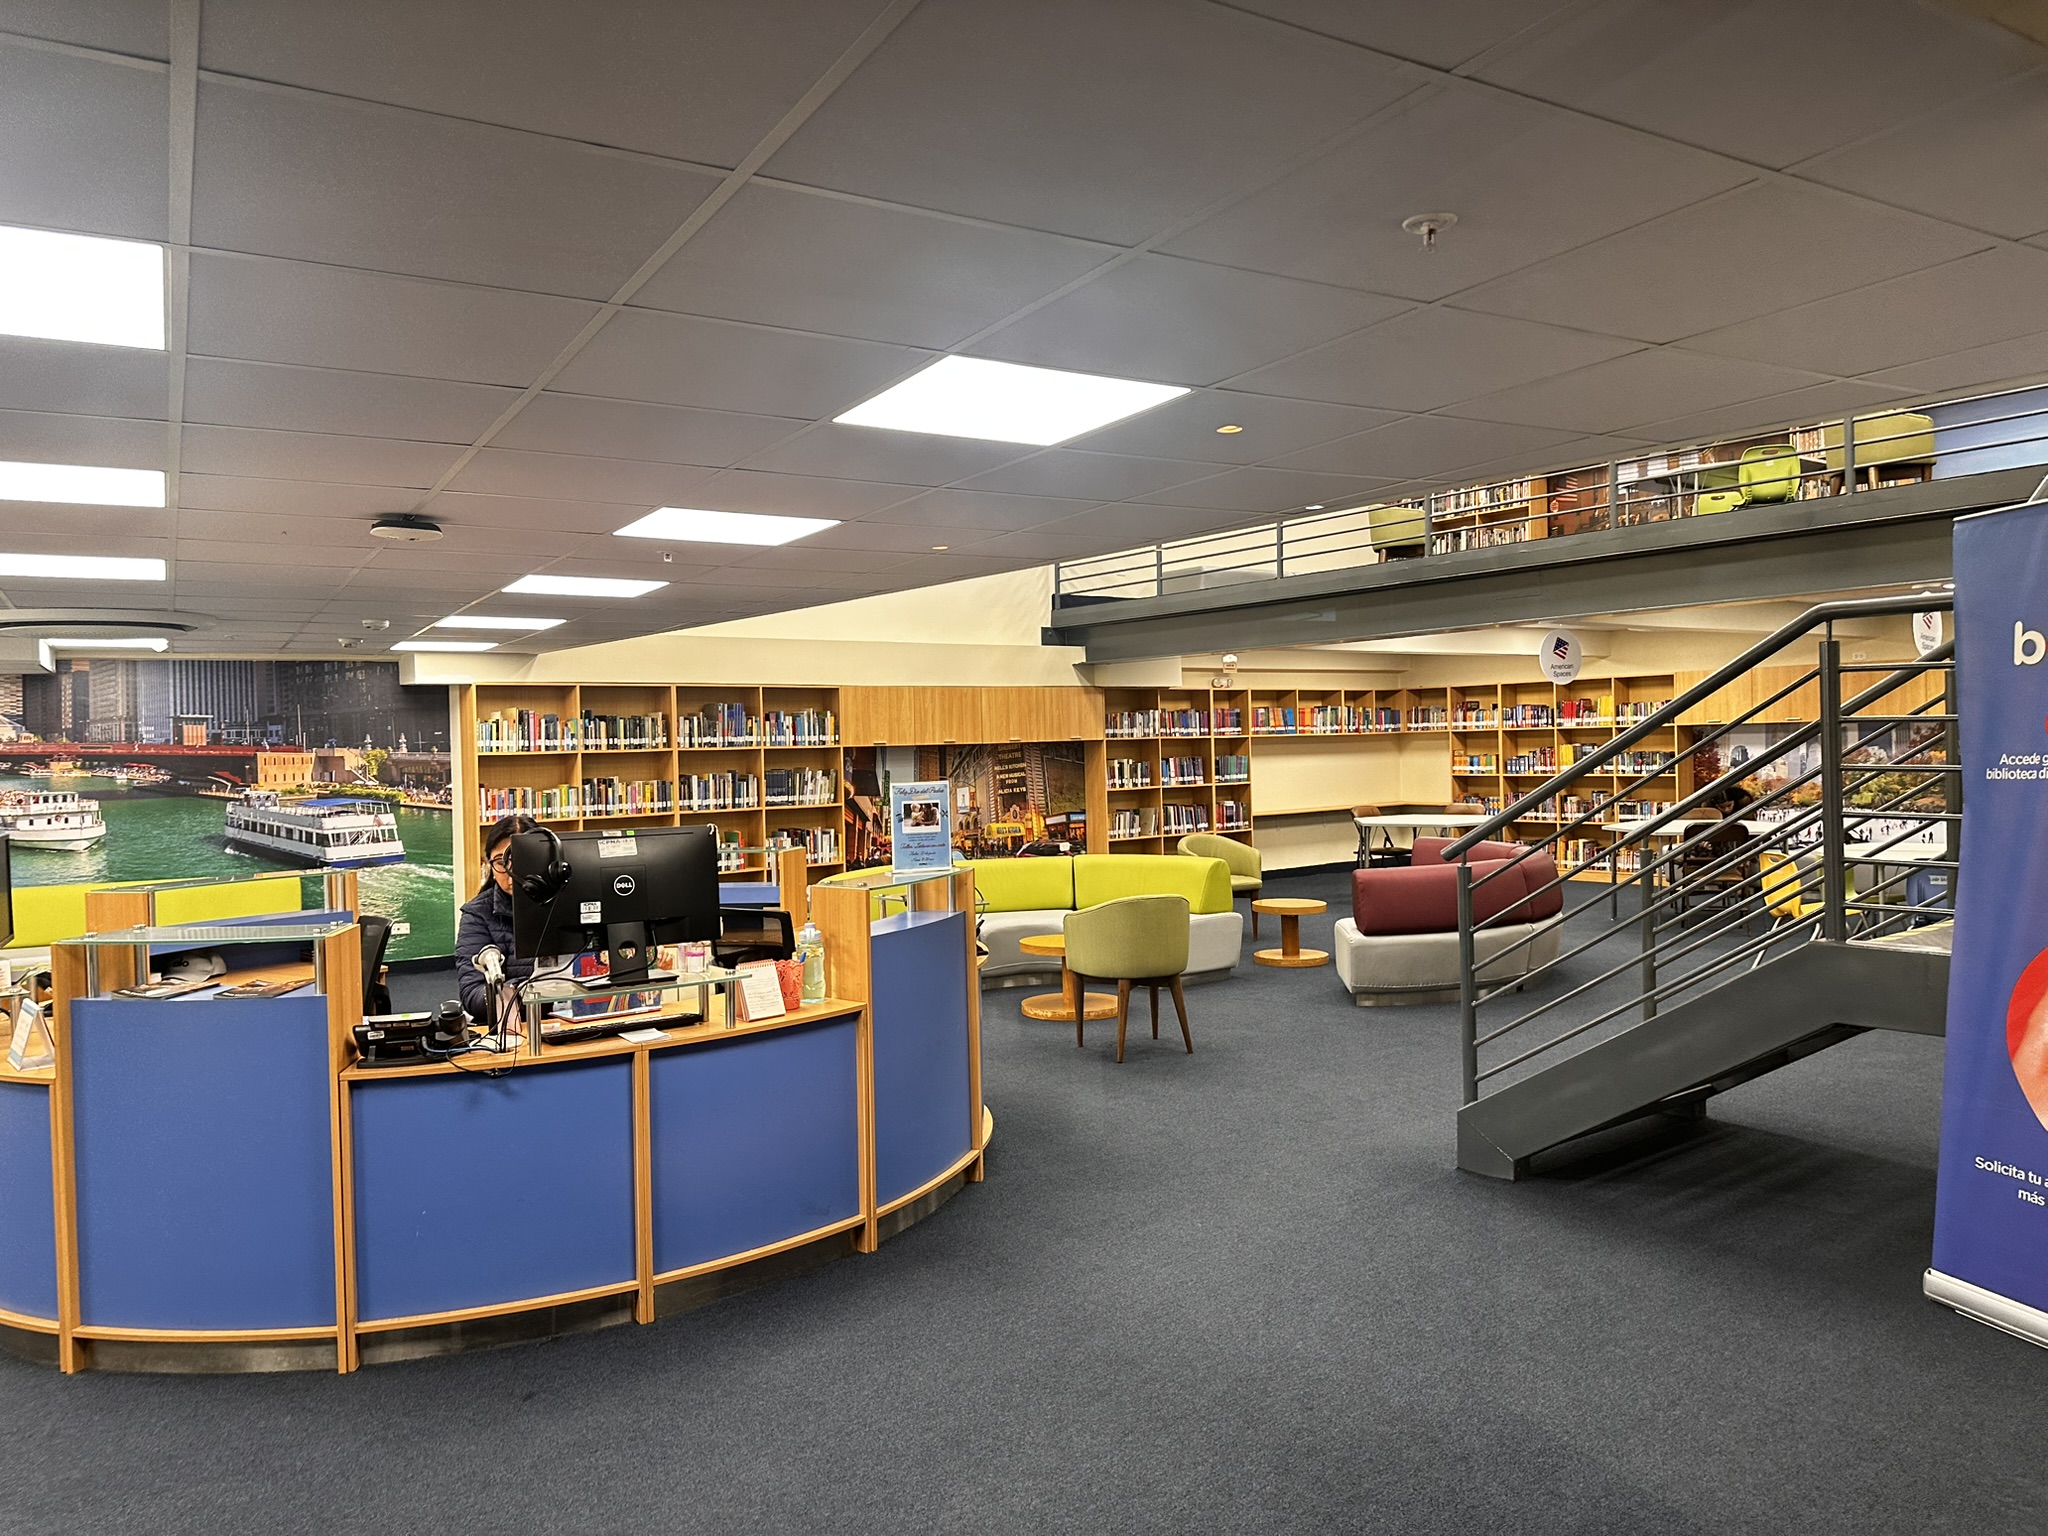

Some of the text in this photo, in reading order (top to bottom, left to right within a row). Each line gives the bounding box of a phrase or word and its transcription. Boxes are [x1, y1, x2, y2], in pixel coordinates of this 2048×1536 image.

[998, 752, 1022, 760] THEATRE
[1999, 753, 2041, 765] Accede
[1986, 768, 2038, 780] biblioteca
[1975, 1156, 2025, 1180] Solicita
[2028, 1171, 2042, 1186] tu
[2018, 1189, 2046, 1206] más
